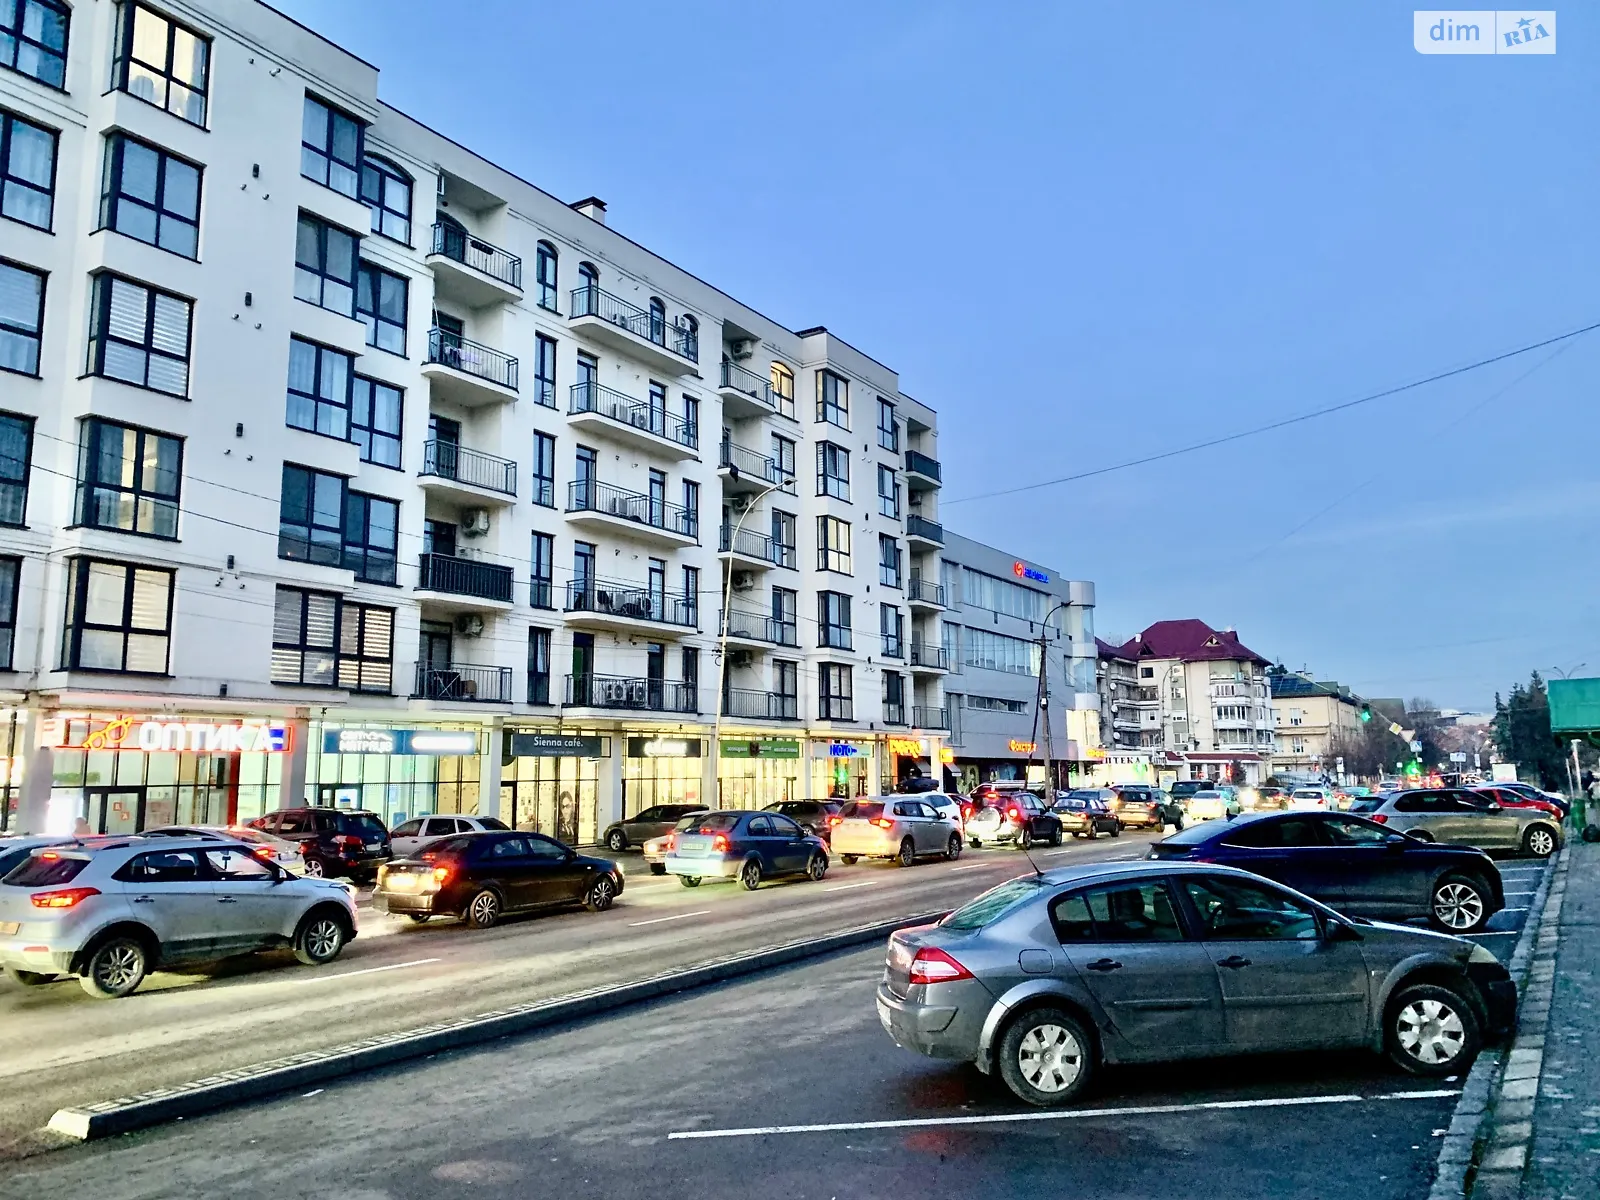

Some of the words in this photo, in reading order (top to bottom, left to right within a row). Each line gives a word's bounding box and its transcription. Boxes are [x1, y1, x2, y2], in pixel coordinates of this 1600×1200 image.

[139, 721, 274, 751] ОПТИКА
[533, 736, 562, 747] Sienna
[564, 737, 584, 747] café.
[1104, 756, 1141, 764] ПТЕКА
